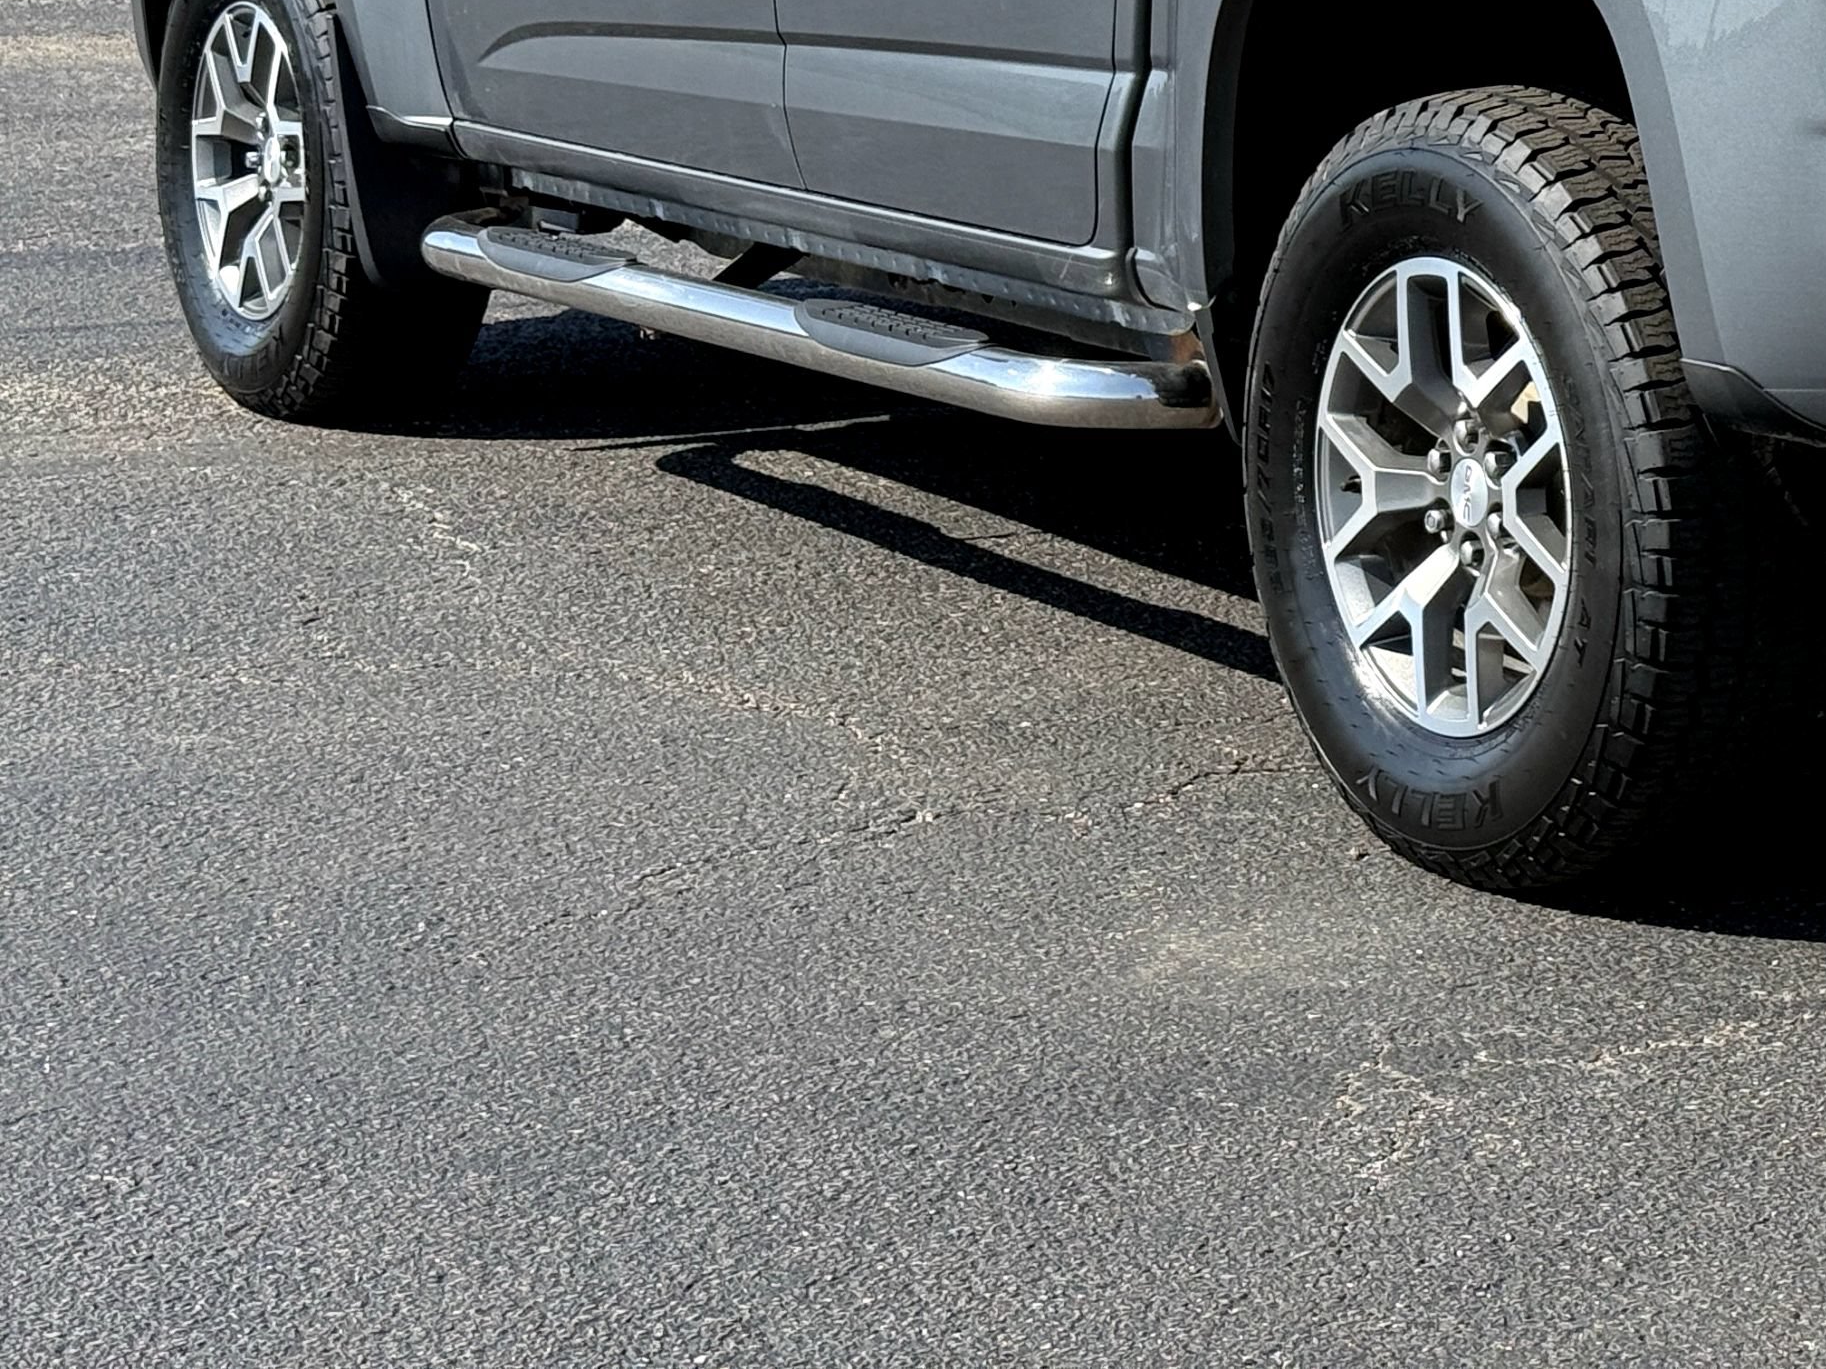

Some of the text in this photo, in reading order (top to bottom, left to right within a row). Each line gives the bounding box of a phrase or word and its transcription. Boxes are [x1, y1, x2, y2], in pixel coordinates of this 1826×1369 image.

[1339, 167, 1485, 234] KELLY
[1463, 464, 1473, 523] GMC
[1355, 764, 1504, 830] KELLY
